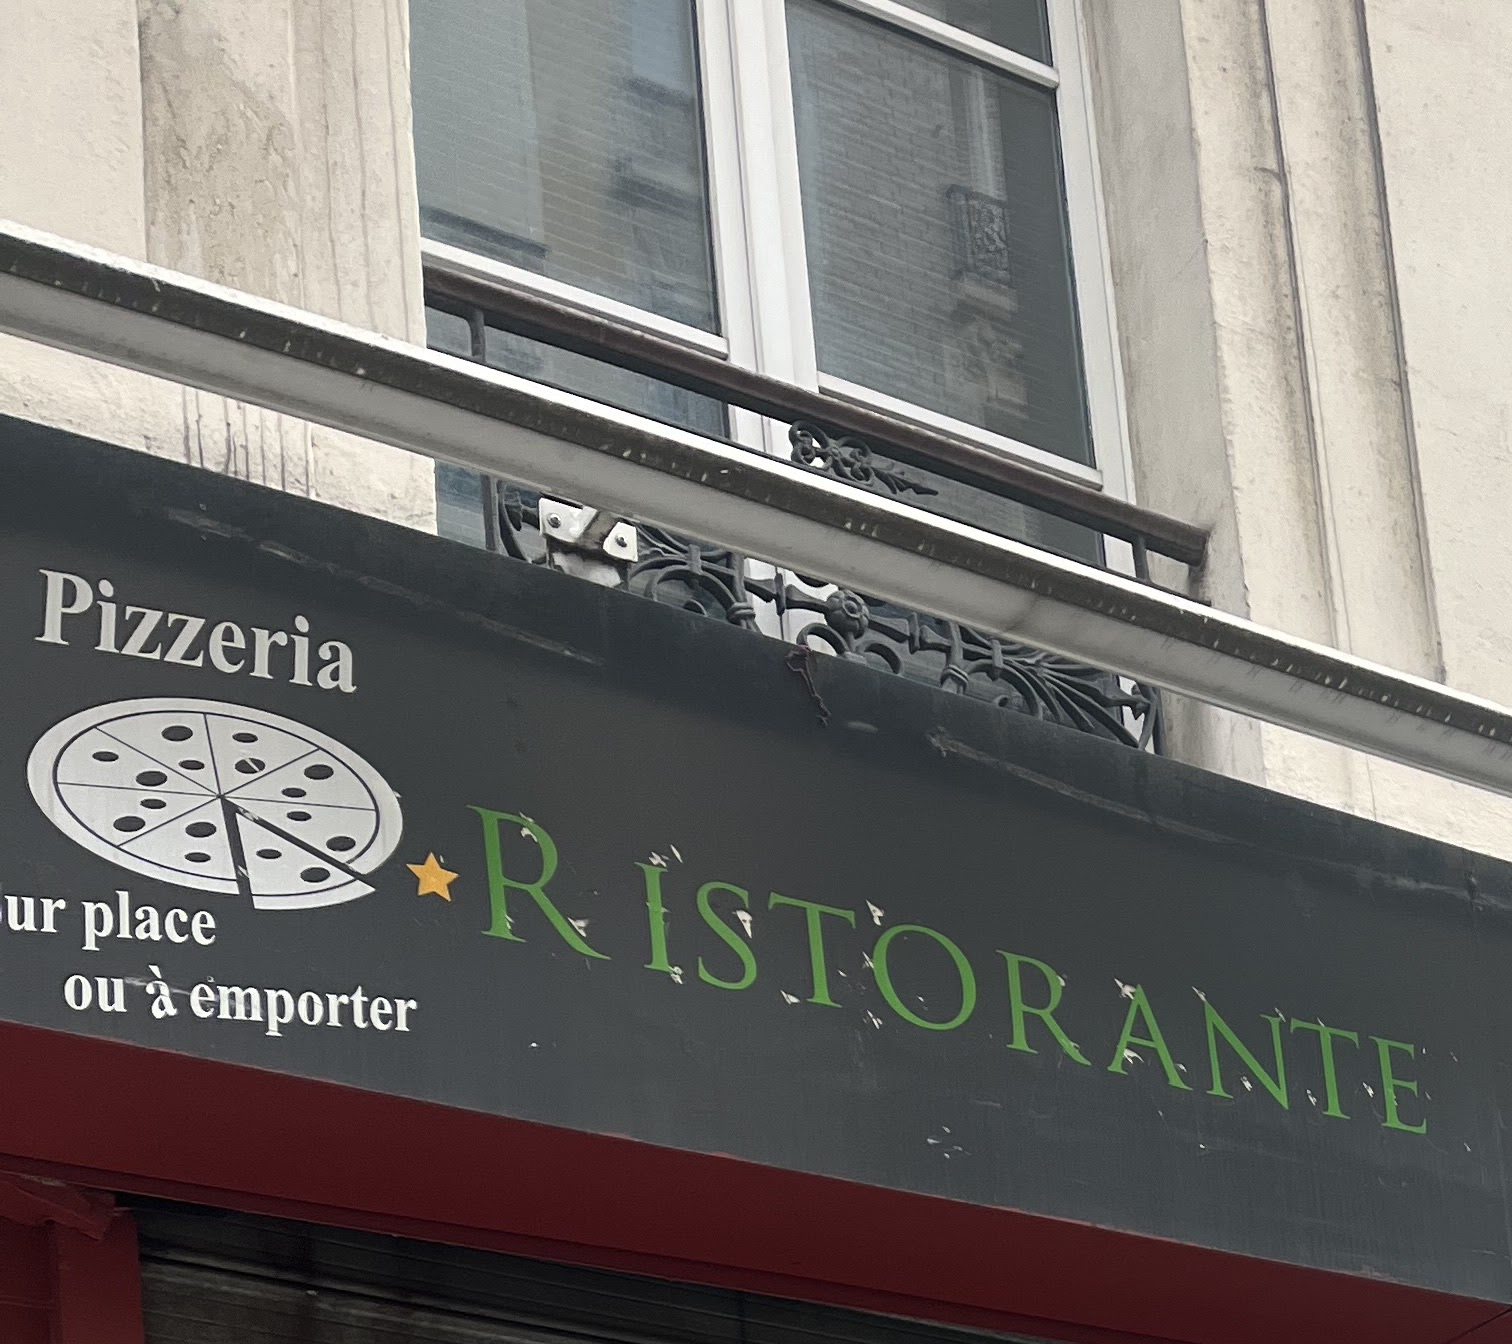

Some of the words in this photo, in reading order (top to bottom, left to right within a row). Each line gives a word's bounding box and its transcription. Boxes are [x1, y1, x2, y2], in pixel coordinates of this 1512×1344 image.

[34, 568, 358, 694] Pizzeria
[0, 894, 67, 934] ur
[81, 889, 217, 951] place
[466, 804, 1428, 1135] RISTORANTE
[63, 973, 127, 1013] ou
[145, 963, 177, 1020] à
[190, 980, 418, 1038] emporter
